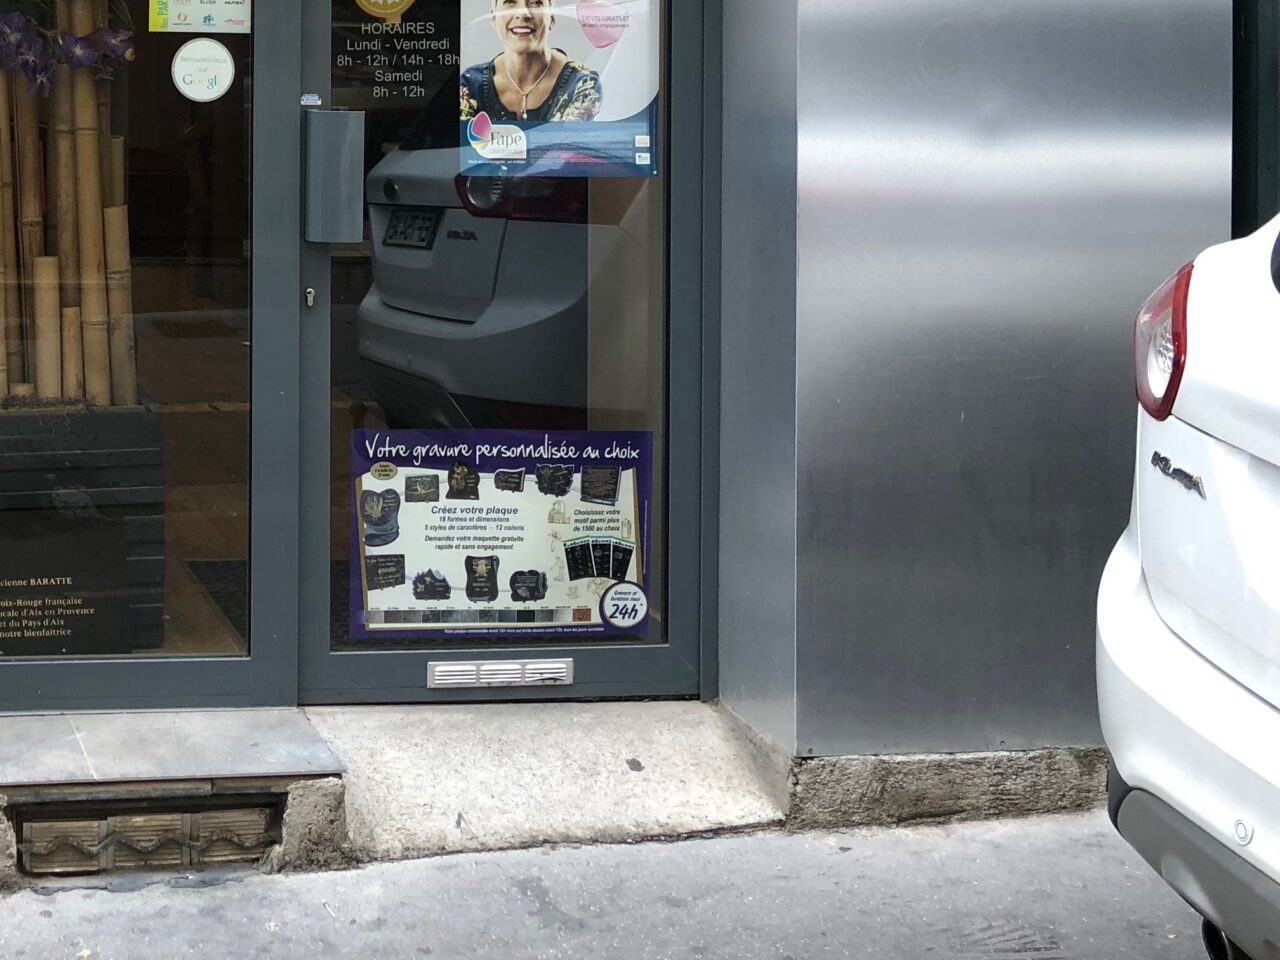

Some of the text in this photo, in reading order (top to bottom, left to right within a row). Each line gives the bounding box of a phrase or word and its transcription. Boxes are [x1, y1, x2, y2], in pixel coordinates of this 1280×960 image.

[361, 22, 435, 35] HORAIRES
[346, 39, 381, 50] Lundi
[393, 38, 450, 50] Vendredi
[336, 55, 352, 66] 8h
[365, 54, 389, 66] 12h
[401, 54, 424, 66] 14h
[437, 53, 460, 65] 18h
[375, 70, 423, 82] Samedi
[373, 86, 389, 97] 8h
[402, 85, 425, 97] 12h
[490, 131, 522, 148] Fape
[366, 433, 640, 466] Votre gravure personnalisée au choix
[431, 506, 518, 515] Créez votre plaque
[30, 577, 72, 586] BARATTE
[45, 597, 83, 607] française
[21, 608, 43, 617] d'Aix
[57, 607, 96, 615] Provence
[9, 619, 20, 627] du
[22, 619, 41, 628] Pays
[0, 630, 22, 638] notre
[24, 628, 72, 637] bienfaitrice
